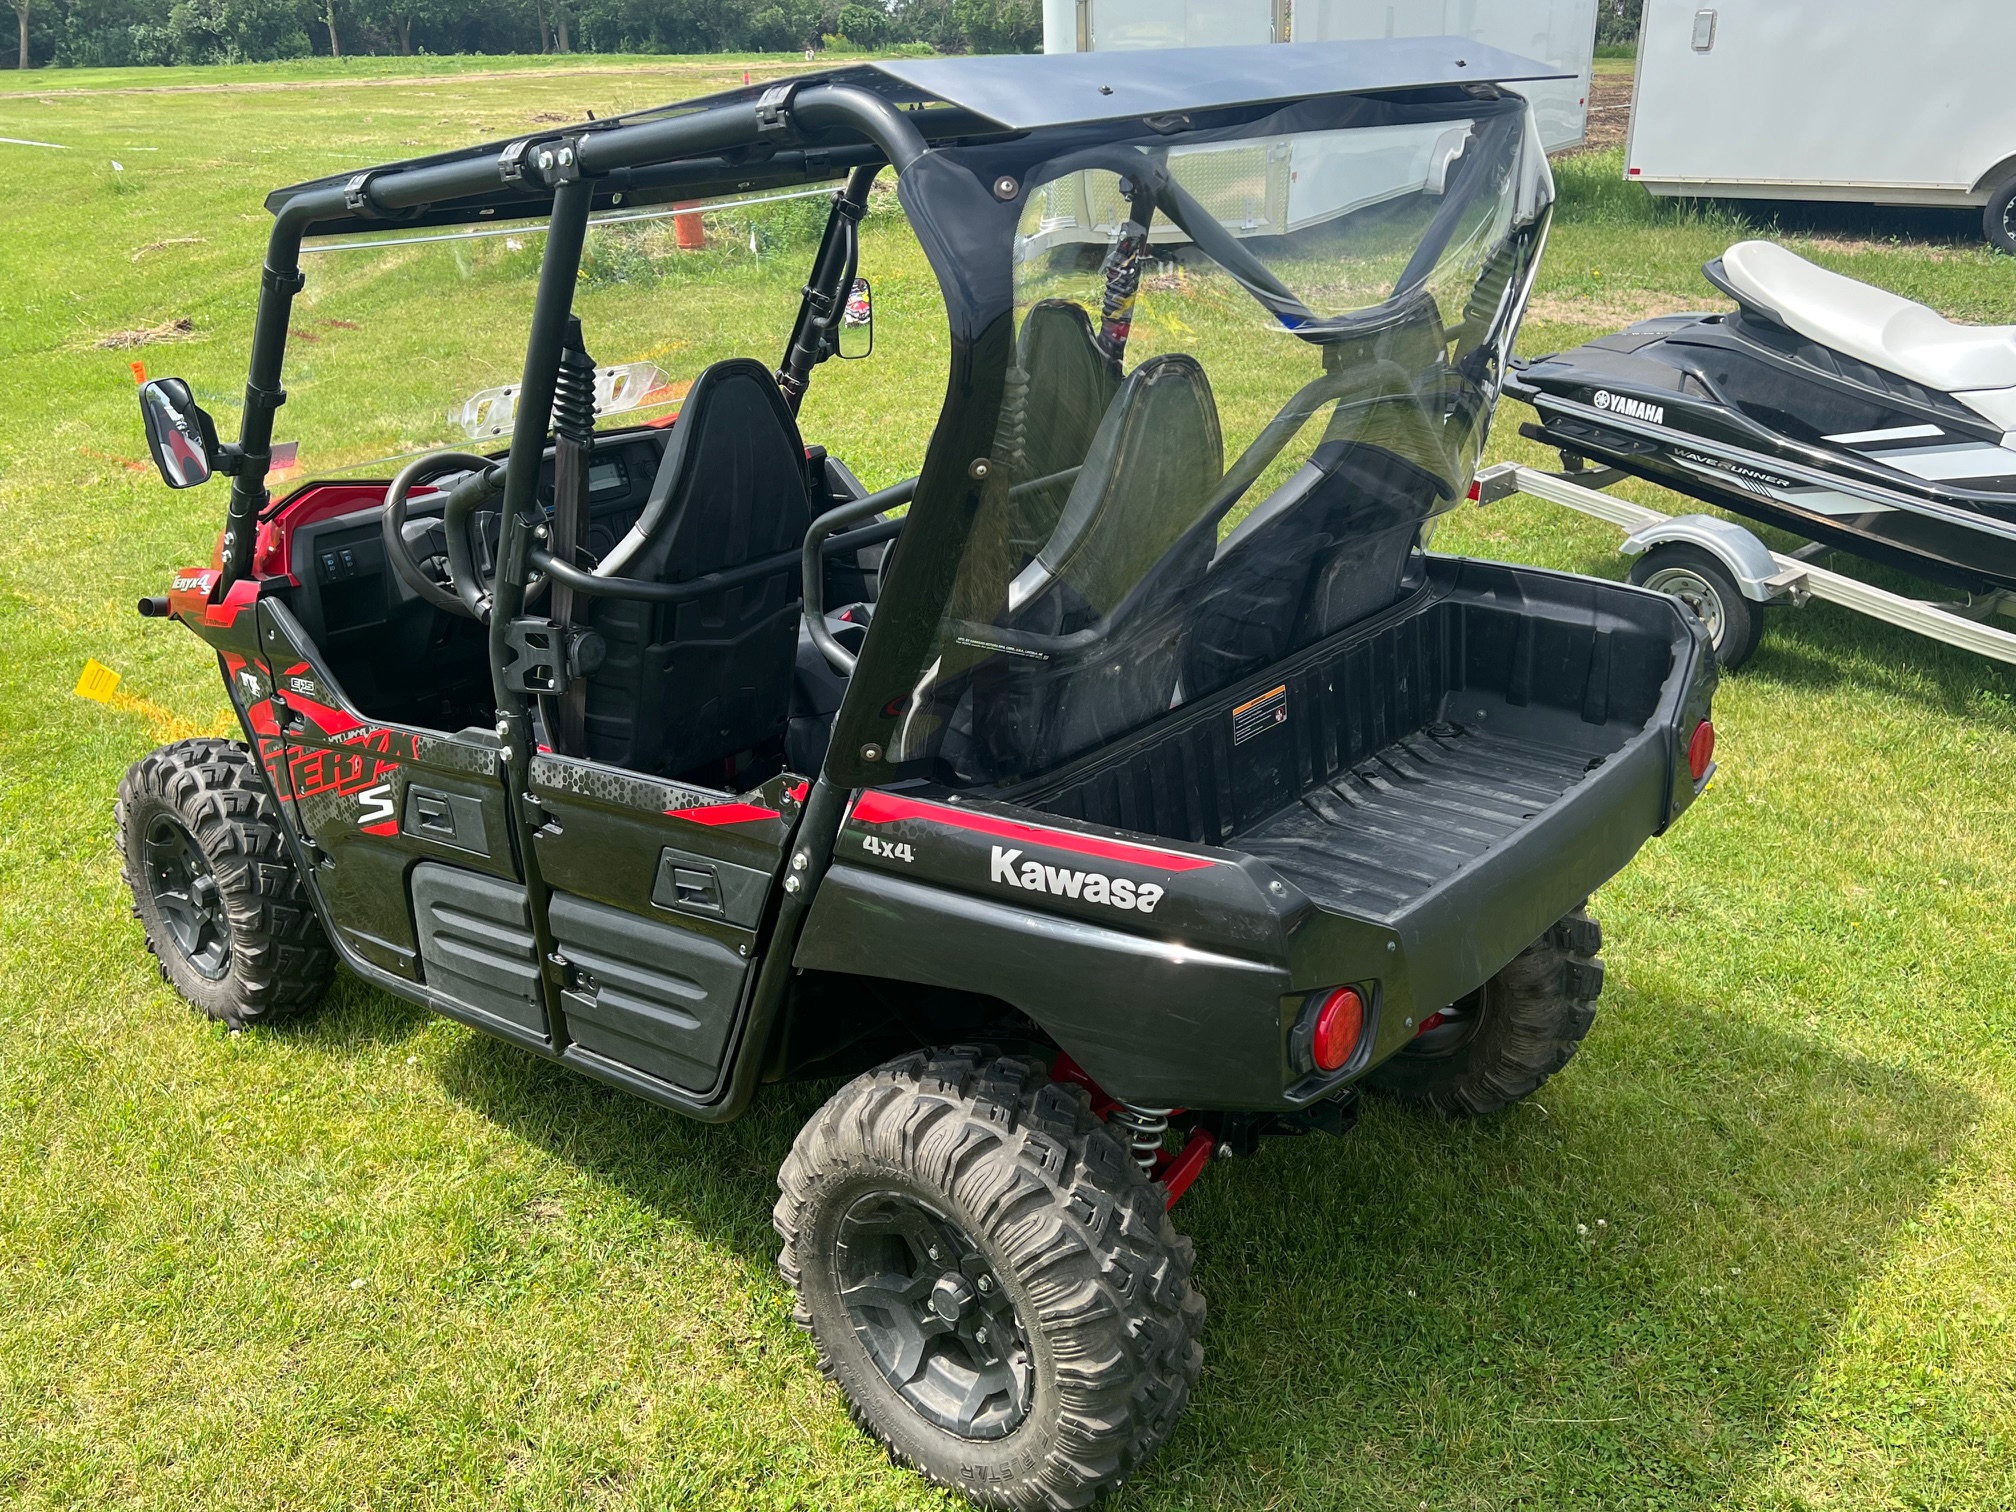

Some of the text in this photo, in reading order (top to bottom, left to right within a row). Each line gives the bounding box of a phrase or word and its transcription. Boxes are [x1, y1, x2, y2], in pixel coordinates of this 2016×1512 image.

[1609, 393, 1664, 425] YAMAHA
[357, 783, 395, 824] S
[862, 835, 915, 863] 4x4
[990, 845, 1165, 914] Kawasa
